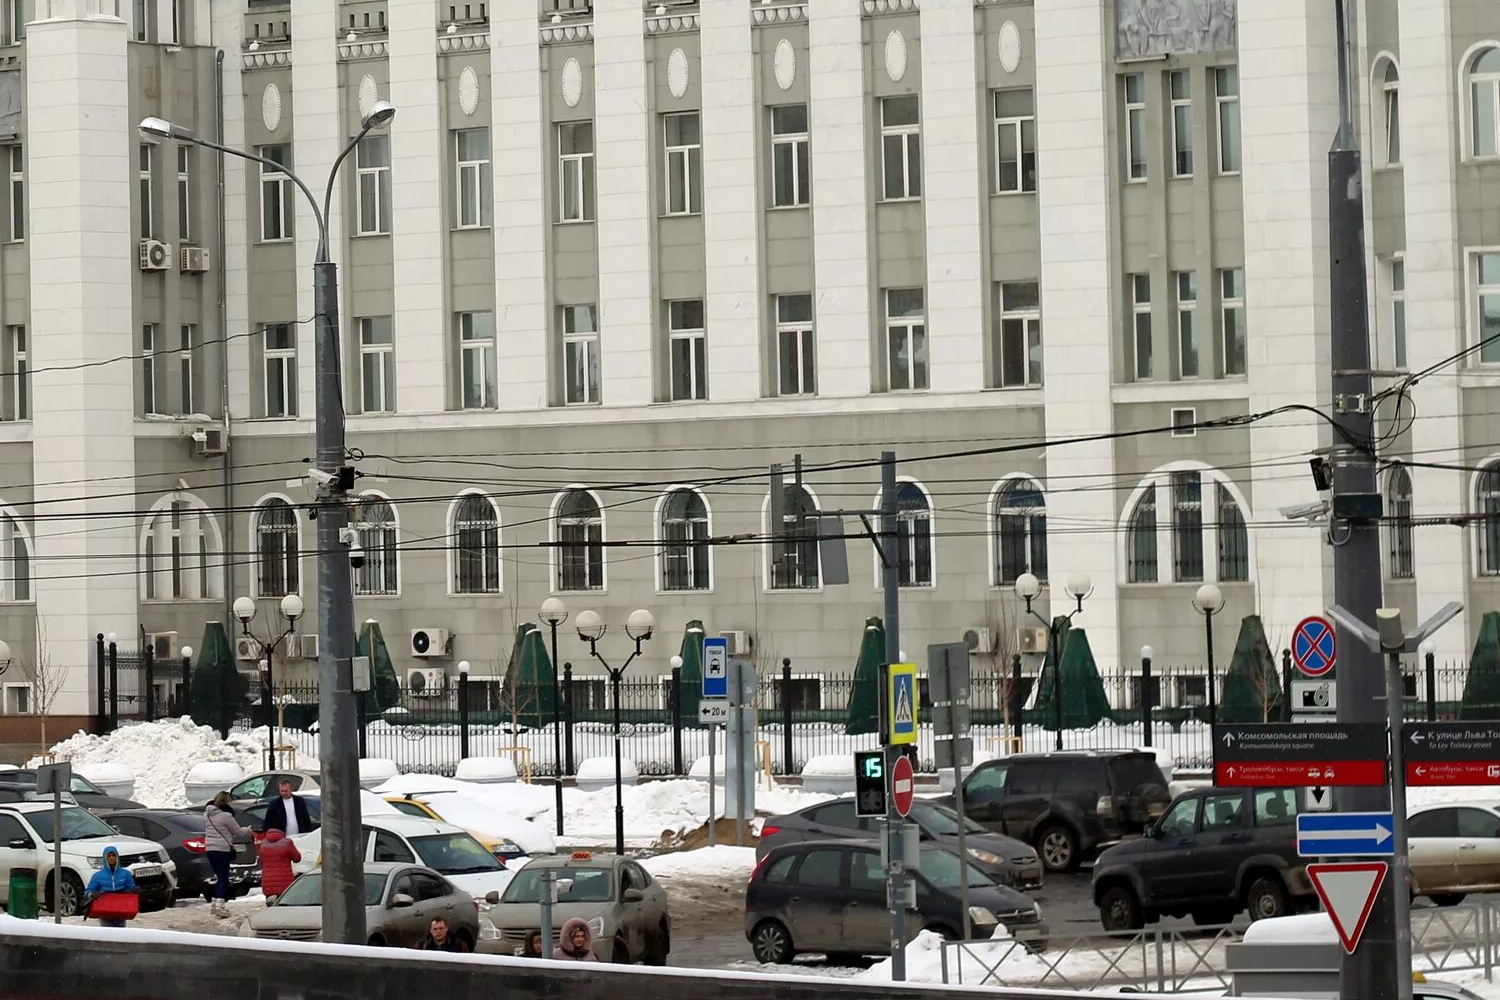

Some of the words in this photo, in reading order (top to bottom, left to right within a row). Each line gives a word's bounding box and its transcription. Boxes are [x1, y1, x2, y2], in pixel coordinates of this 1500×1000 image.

[711, 707, 720, 716] 20
[1238, 732, 1307, 740] Комсомольская
[1308, 732, 1348, 741] площадь
[1428, 731, 1434, 739] К
[1436, 731, 1462, 741] улице
[1464, 730, 1486, 739] Льва
[865, 757, 882, 778] 15
